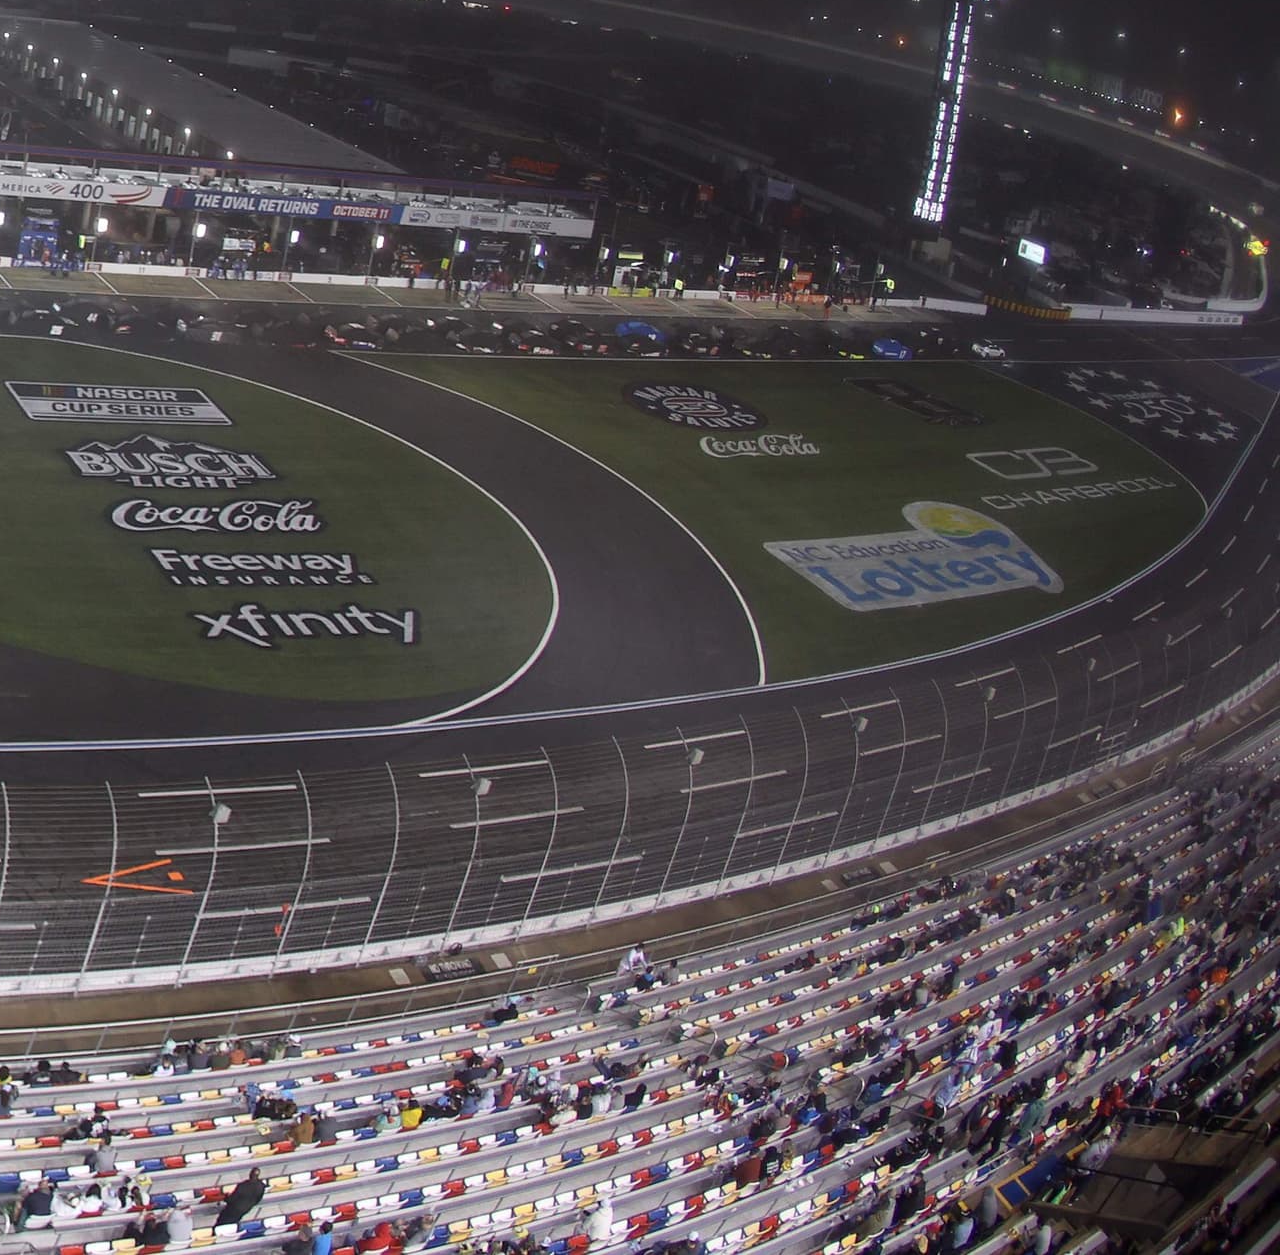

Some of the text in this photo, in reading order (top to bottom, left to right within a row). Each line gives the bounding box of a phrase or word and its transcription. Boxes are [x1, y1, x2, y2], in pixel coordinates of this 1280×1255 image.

[69, 183, 104, 199] 400
[194, 194, 320, 216] THE OVAL RETURNS
[333, 205, 390, 220] OCTOBER 11
[75, 386, 179, 402] NASCAR
[633, 385, 718, 401] NASCAR
[51, 401, 196, 417] CUP SERIES
[699, 433, 821, 458] Coca-Cola
[66, 449, 276, 479] BUSCH
[131, 475, 242, 489] LIGHT
[980, 476, 1177, 510] CHARBROIL
[111, 499, 322, 533] Coca-Cola
[781, 535, 946, 563] NC Education
[150, 548, 354, 575] Freeway
[171, 575, 375, 585] INSURANCE
[805, 546, 1052, 603] Lottery
[195, 603, 415, 647] xfinity
